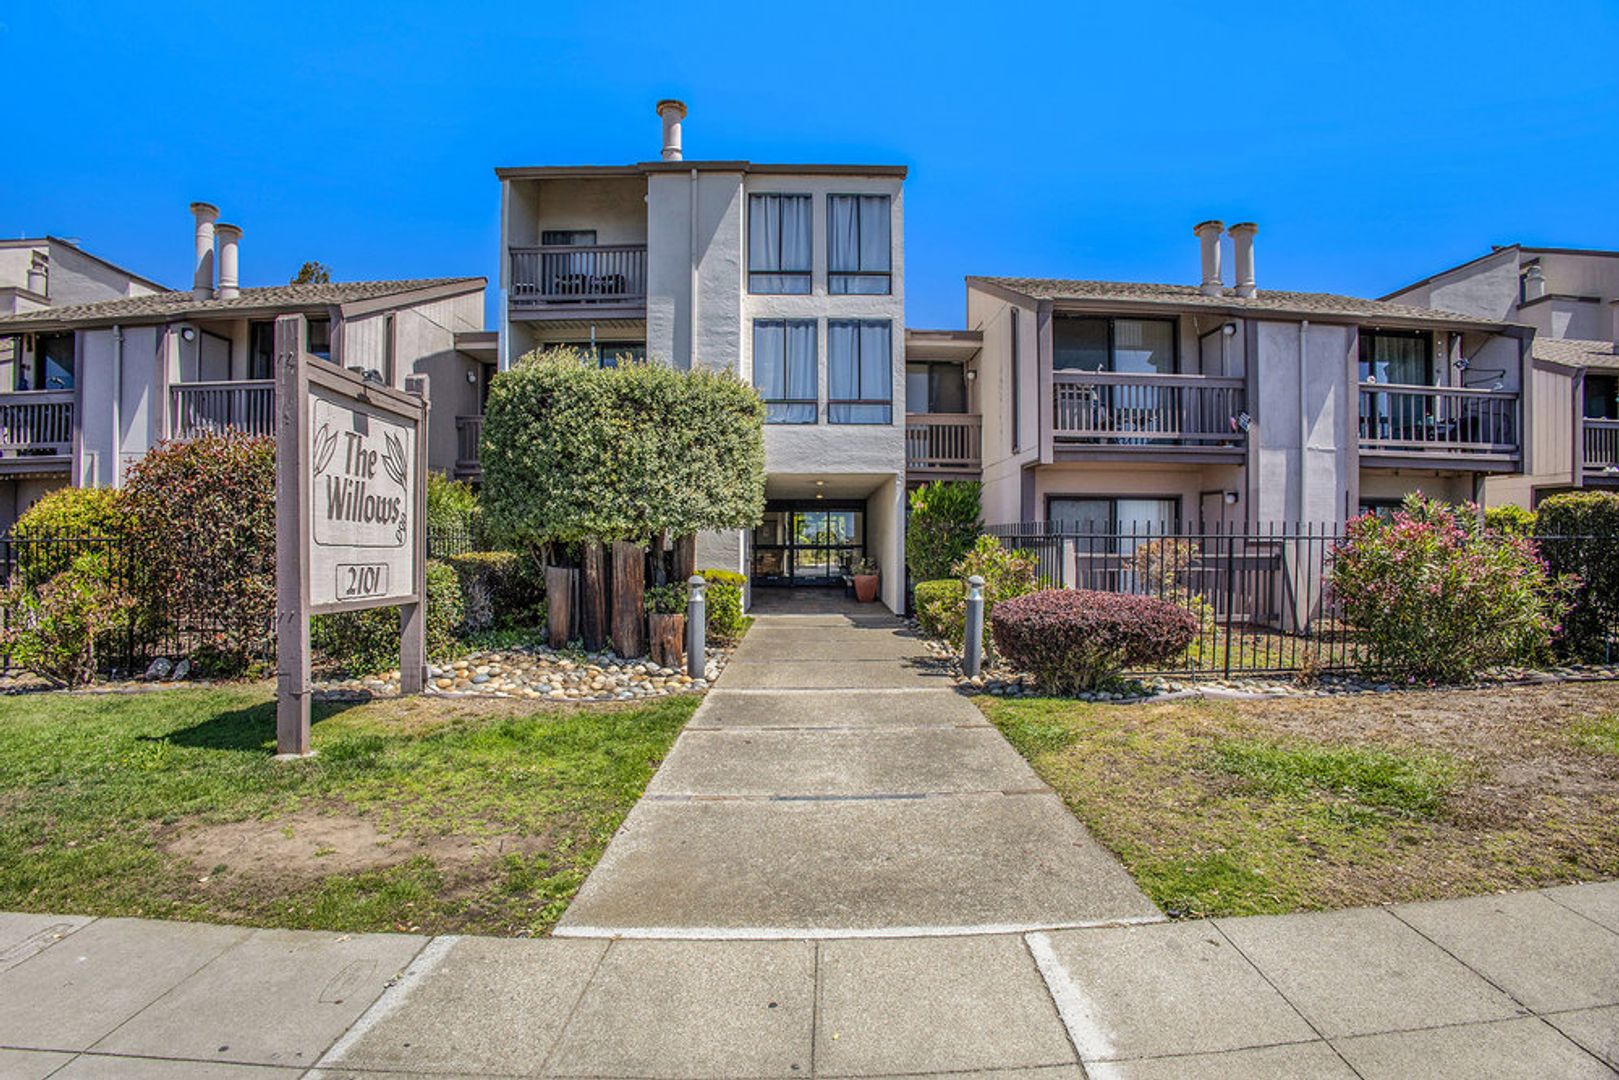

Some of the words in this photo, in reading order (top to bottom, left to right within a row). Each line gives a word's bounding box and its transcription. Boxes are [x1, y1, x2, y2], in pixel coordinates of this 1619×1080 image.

[344, 431, 377, 480] The
[326, 474, 400, 525] Willows
[346, 567, 380, 595] 2101
